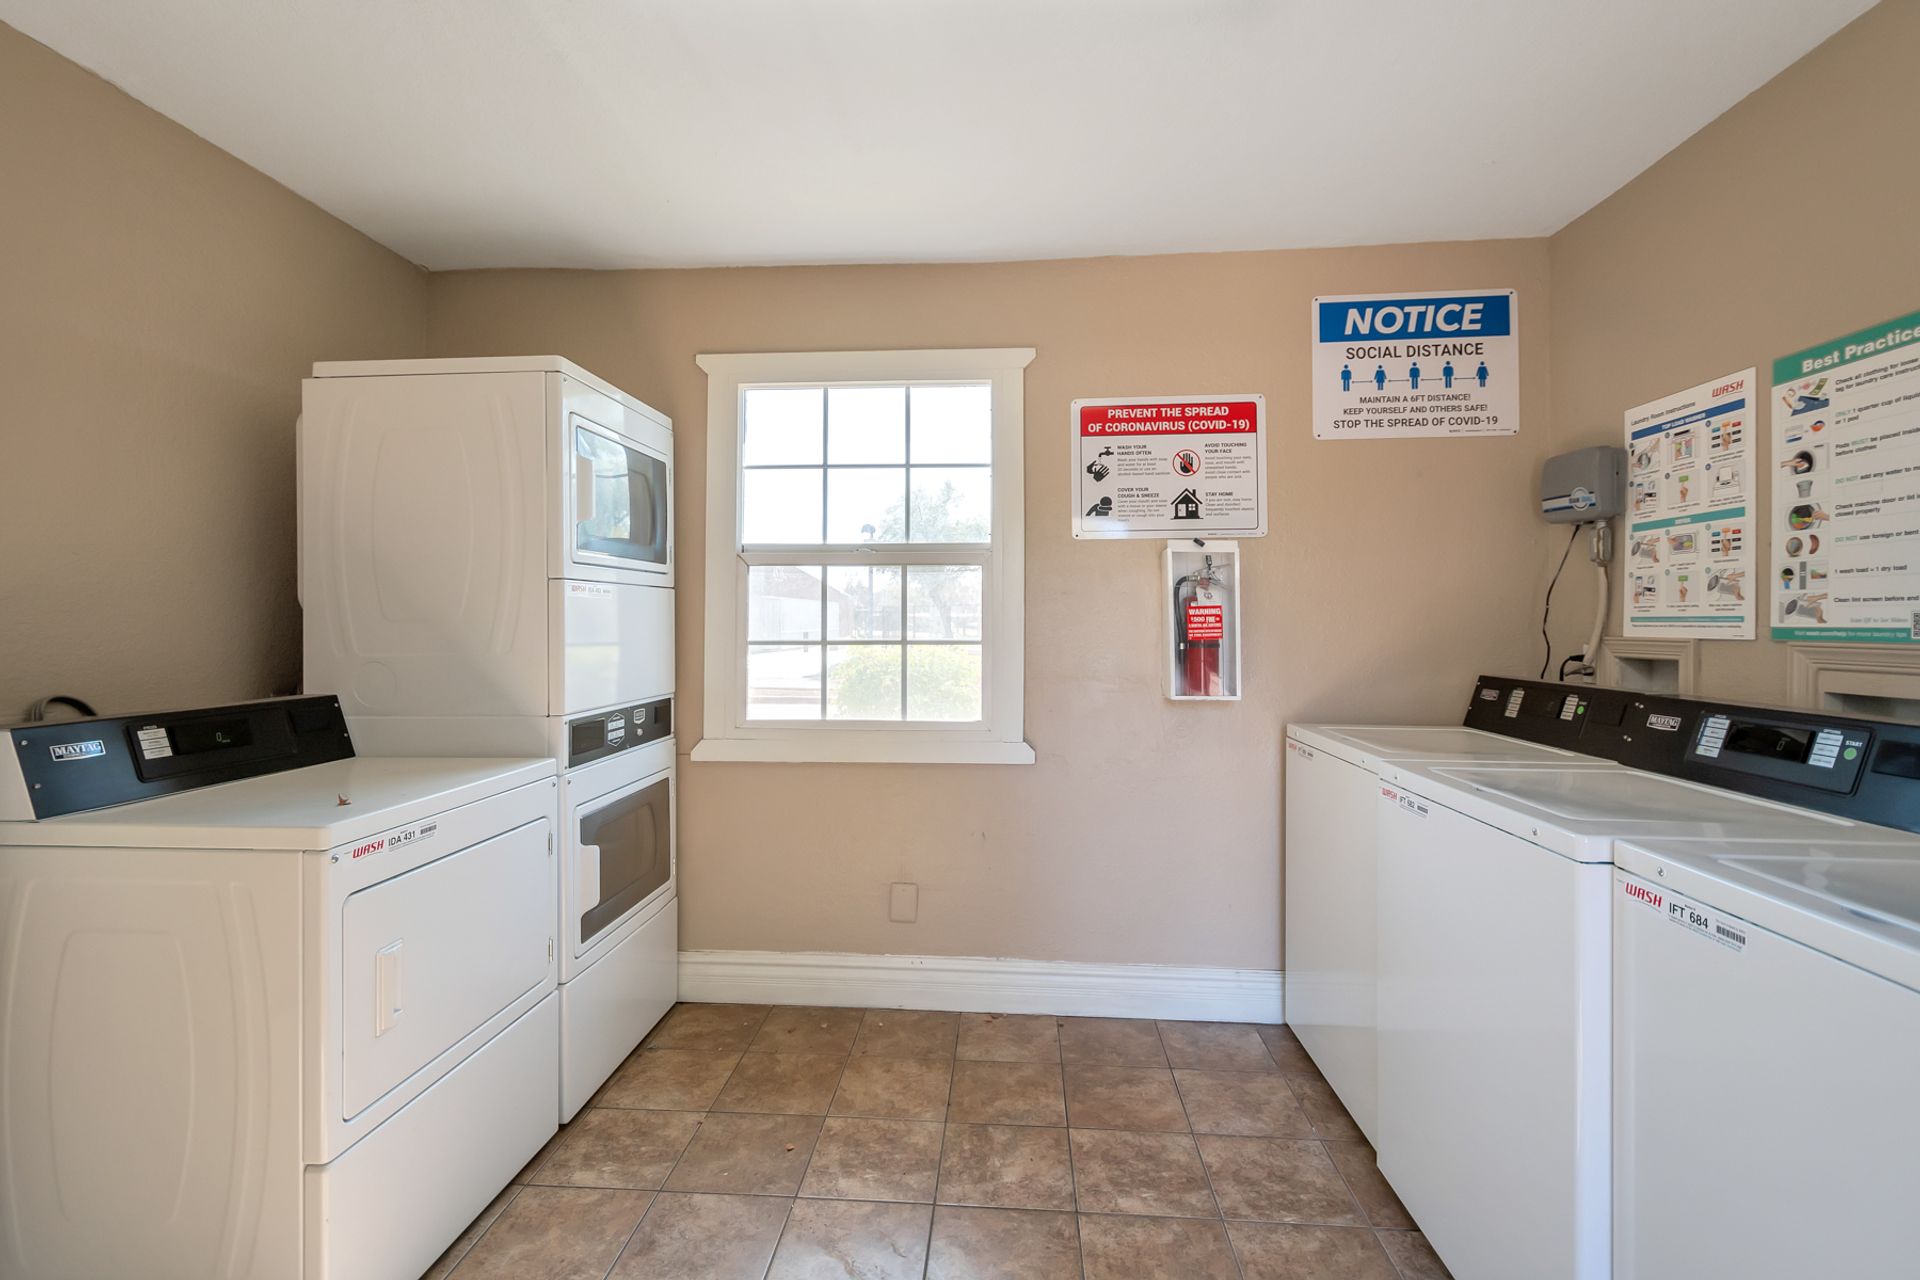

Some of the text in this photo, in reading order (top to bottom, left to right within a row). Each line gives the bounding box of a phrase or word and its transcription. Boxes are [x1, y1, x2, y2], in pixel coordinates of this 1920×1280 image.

[1344, 303, 1484, 335] NOTICE
[1346, 342, 1484, 360] SOCIAL DISTANCE
[1802, 350, 1840, 372] Best
[1712, 380, 1744, 398] WASH
[1360, 396, 1400, 404] MAINTAIN
[1428, 394, 1471, 402] DISTANCE!
[1108, 406, 1229, 418] PREVENT THE SPREAD
[1429, 405, 1462, 413] OTHERS
[1464, 404, 1488, 412] SAFE!
[1088, 419, 1250, 432] OF CORONAVIRUS (COVID-19)
[1333, 416, 1498, 429] STOP THE SPREAD OF COVID-19
[1650, 716, 1678, 726] MAYTAG
[54, 742, 102, 756] MAYTAG
[388, 831, 415, 846] IDA 431
[352, 840, 384, 858] WASH
[1625, 882, 1662, 908] WASH
[1669, 902, 1708, 929] IFT 684
